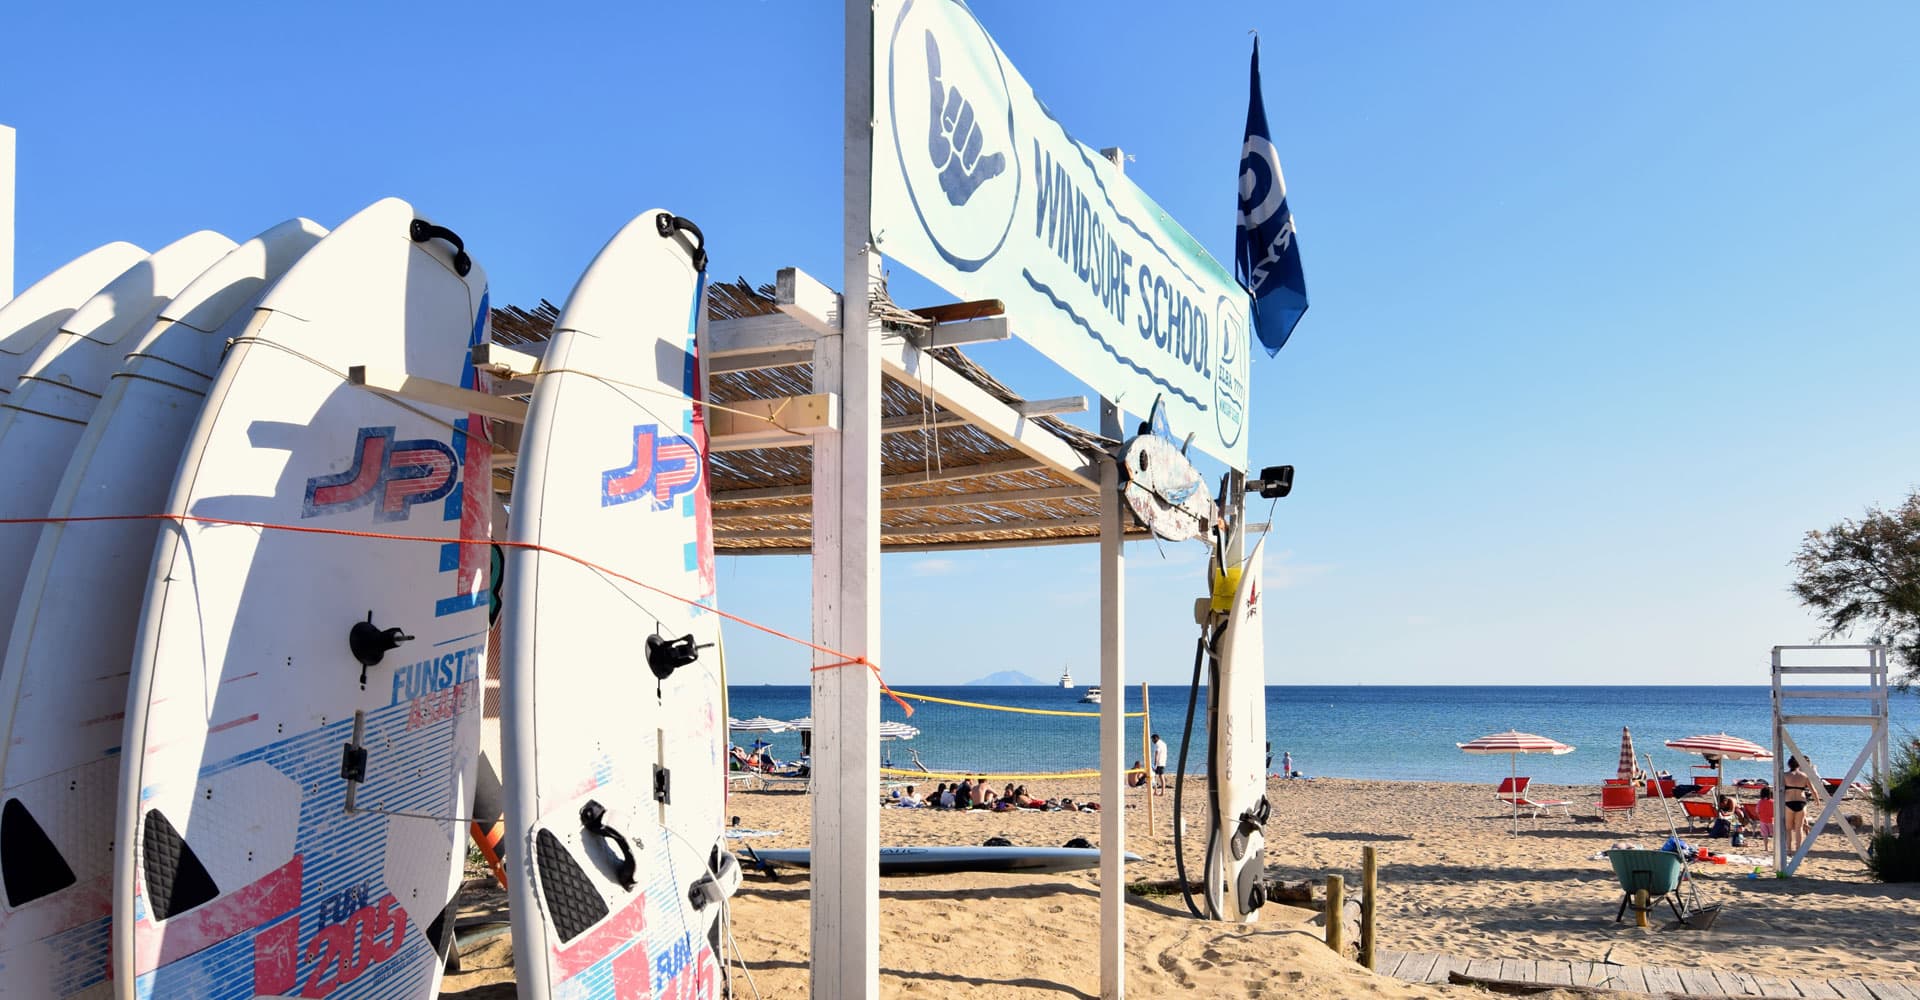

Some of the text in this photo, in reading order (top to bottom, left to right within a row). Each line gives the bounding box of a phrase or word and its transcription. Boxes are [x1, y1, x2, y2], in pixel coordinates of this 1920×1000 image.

[1033, 136, 1211, 380] WINDSURF SCHOOL
[301, 426, 458, 524] JP
[601, 424, 702, 512] JP
[391, 645, 485, 707] FUNSTE
[300, 892, 408, 999] 205
[319, 879, 370, 931] FUN
